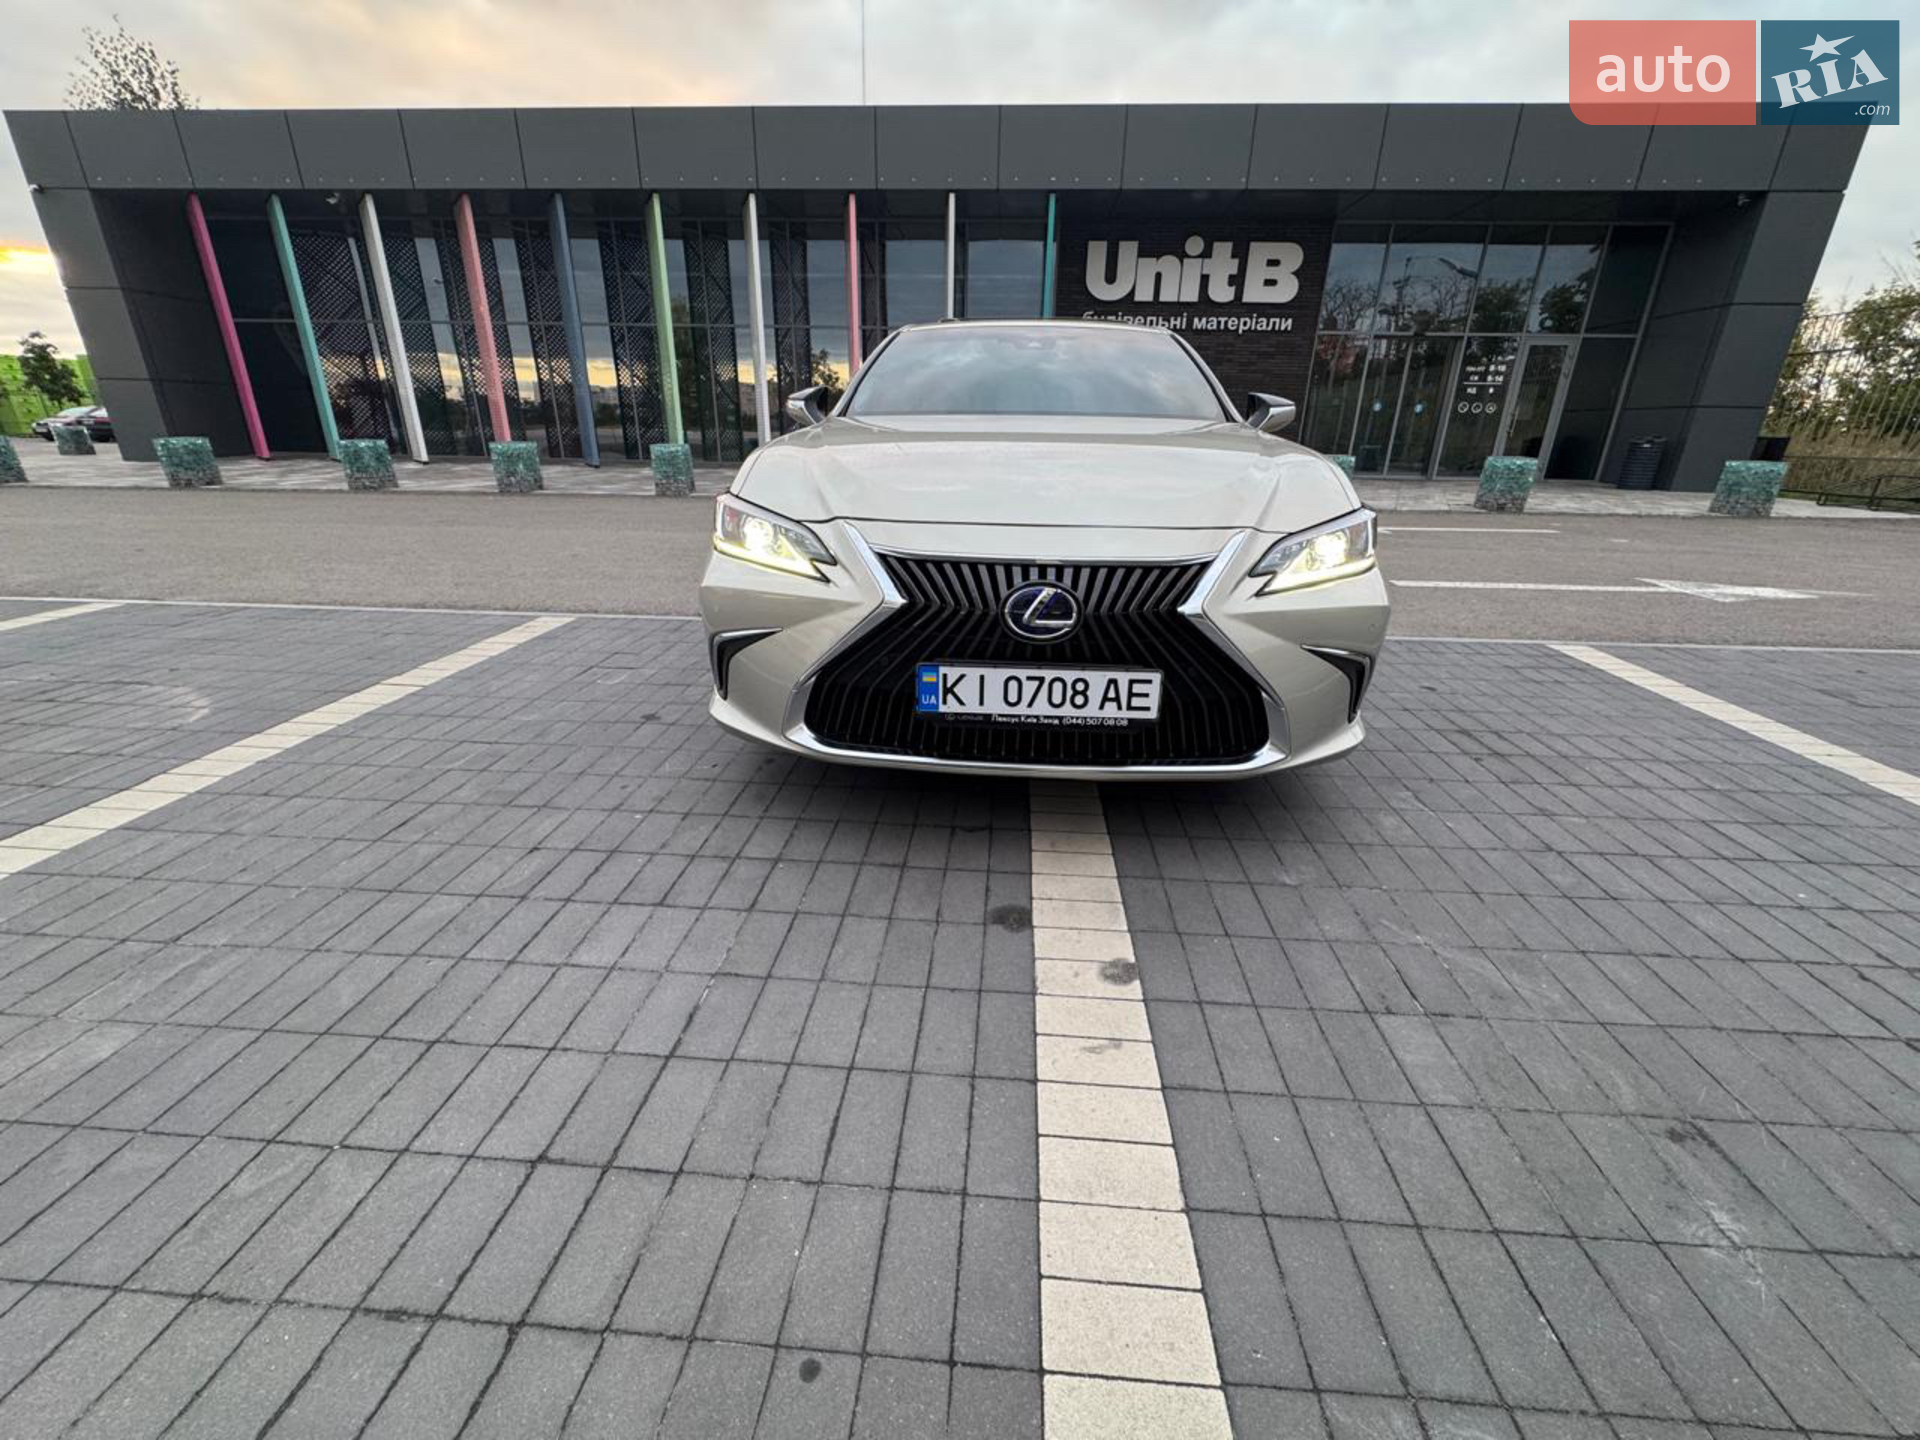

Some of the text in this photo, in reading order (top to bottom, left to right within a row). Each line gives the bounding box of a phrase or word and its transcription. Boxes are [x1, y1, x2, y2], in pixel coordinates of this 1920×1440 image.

[1085, 235, 1304, 304] UnitB
[1192, 312, 1293, 335] матеріали
[921, 694, 938, 706] UA
[941, 672, 1153, 712] KI 0708 AE
[1062, 717, 1085, 727] (044)
[1085, 718, 1102, 726] 507
